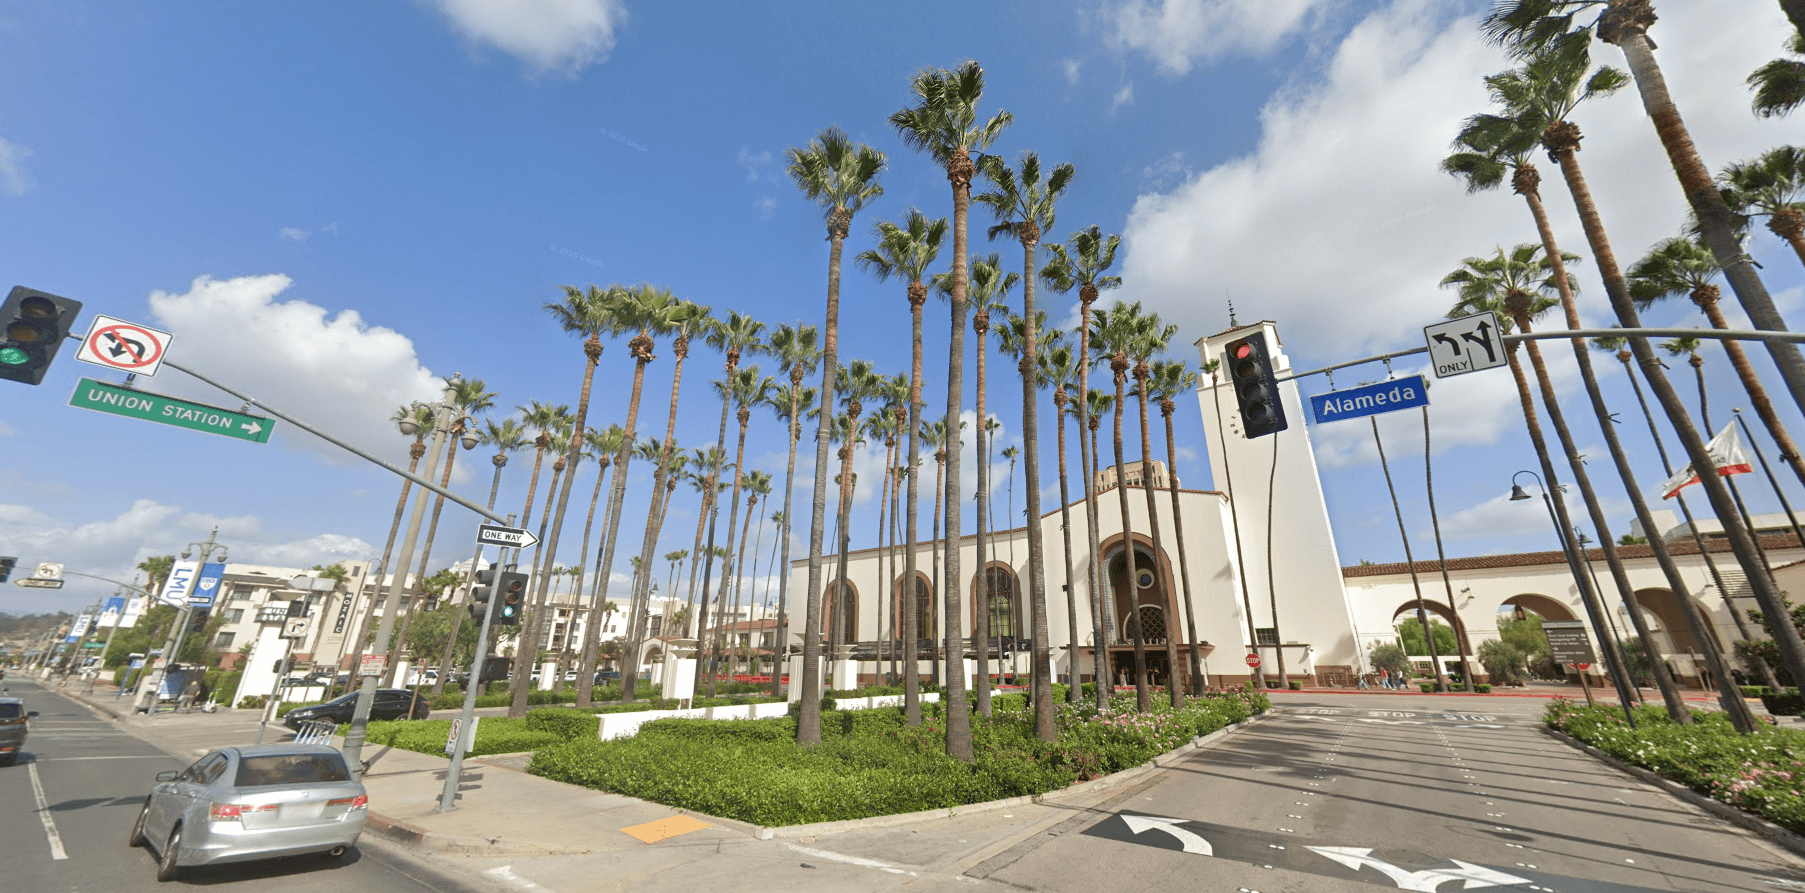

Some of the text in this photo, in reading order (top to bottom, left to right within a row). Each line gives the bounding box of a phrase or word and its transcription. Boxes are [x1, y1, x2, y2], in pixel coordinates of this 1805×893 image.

[1439, 360, 1468, 374] ONLY
[88, 388, 233, 428] UNION STATION
[1323, 386, 1416, 416] Alameda
[484, 530, 522, 541] ONE WAY
[166, 568, 193, 600] LMU
[335, 593, 353, 633] MOZAIC
[1443, 714, 1498, 722] STOP
